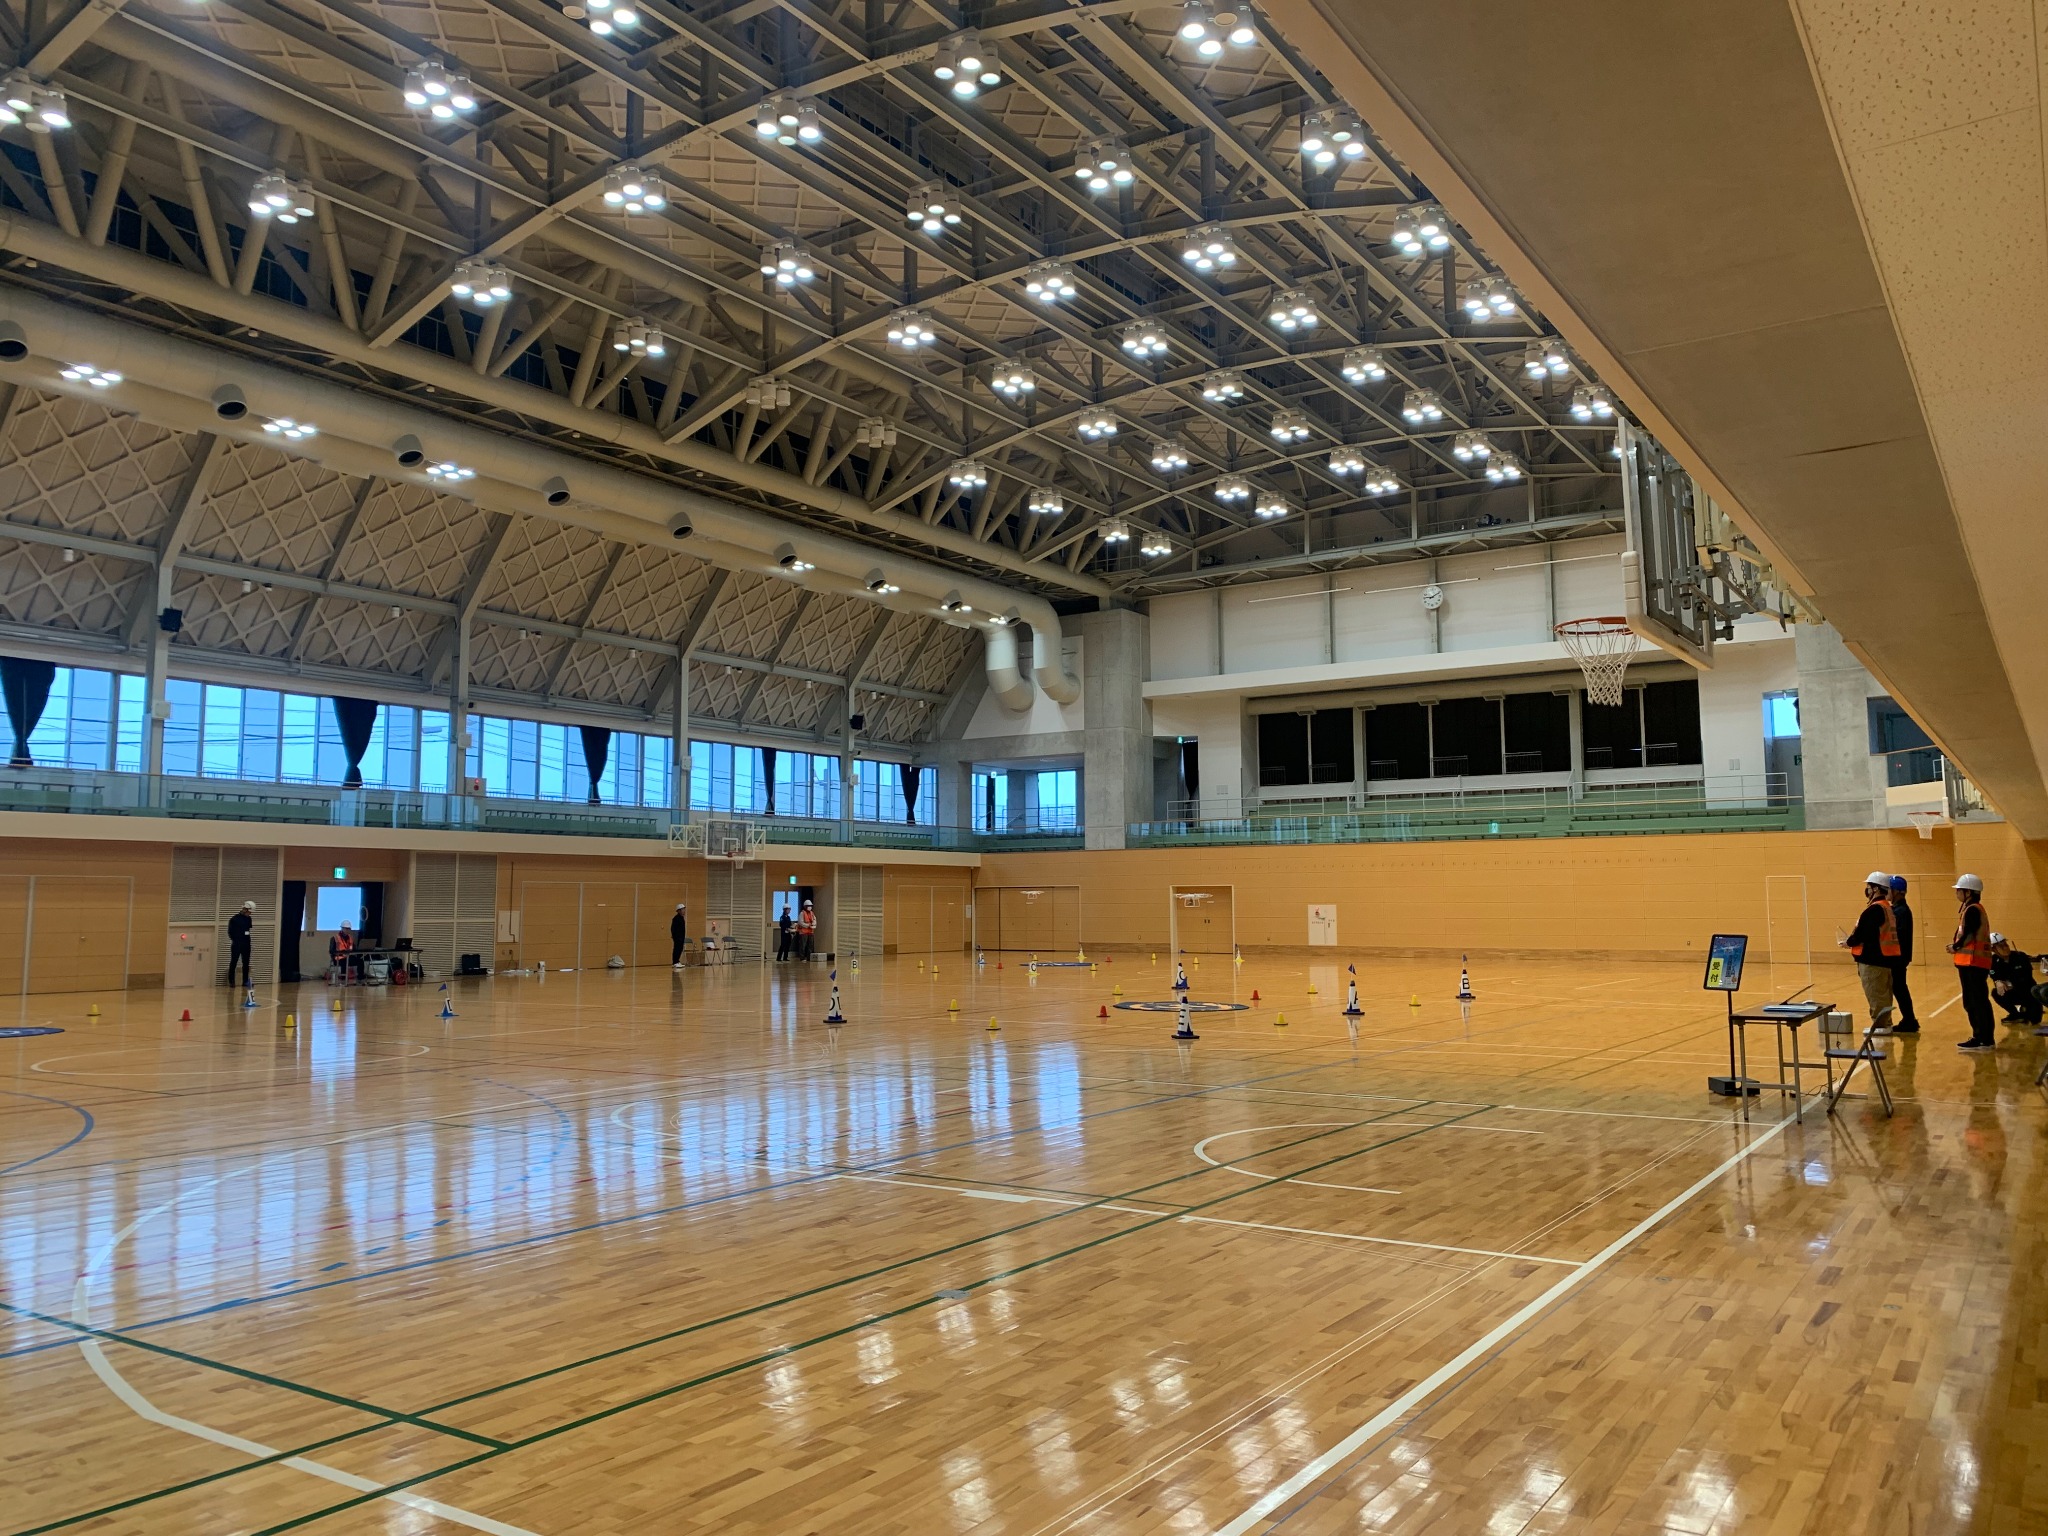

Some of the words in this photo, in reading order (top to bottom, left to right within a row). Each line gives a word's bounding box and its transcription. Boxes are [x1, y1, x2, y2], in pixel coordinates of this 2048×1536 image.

[853, 960, 858, 969] B
[1710, 961, 1721, 983] 受付
[1462, 978, 1470, 989] B
